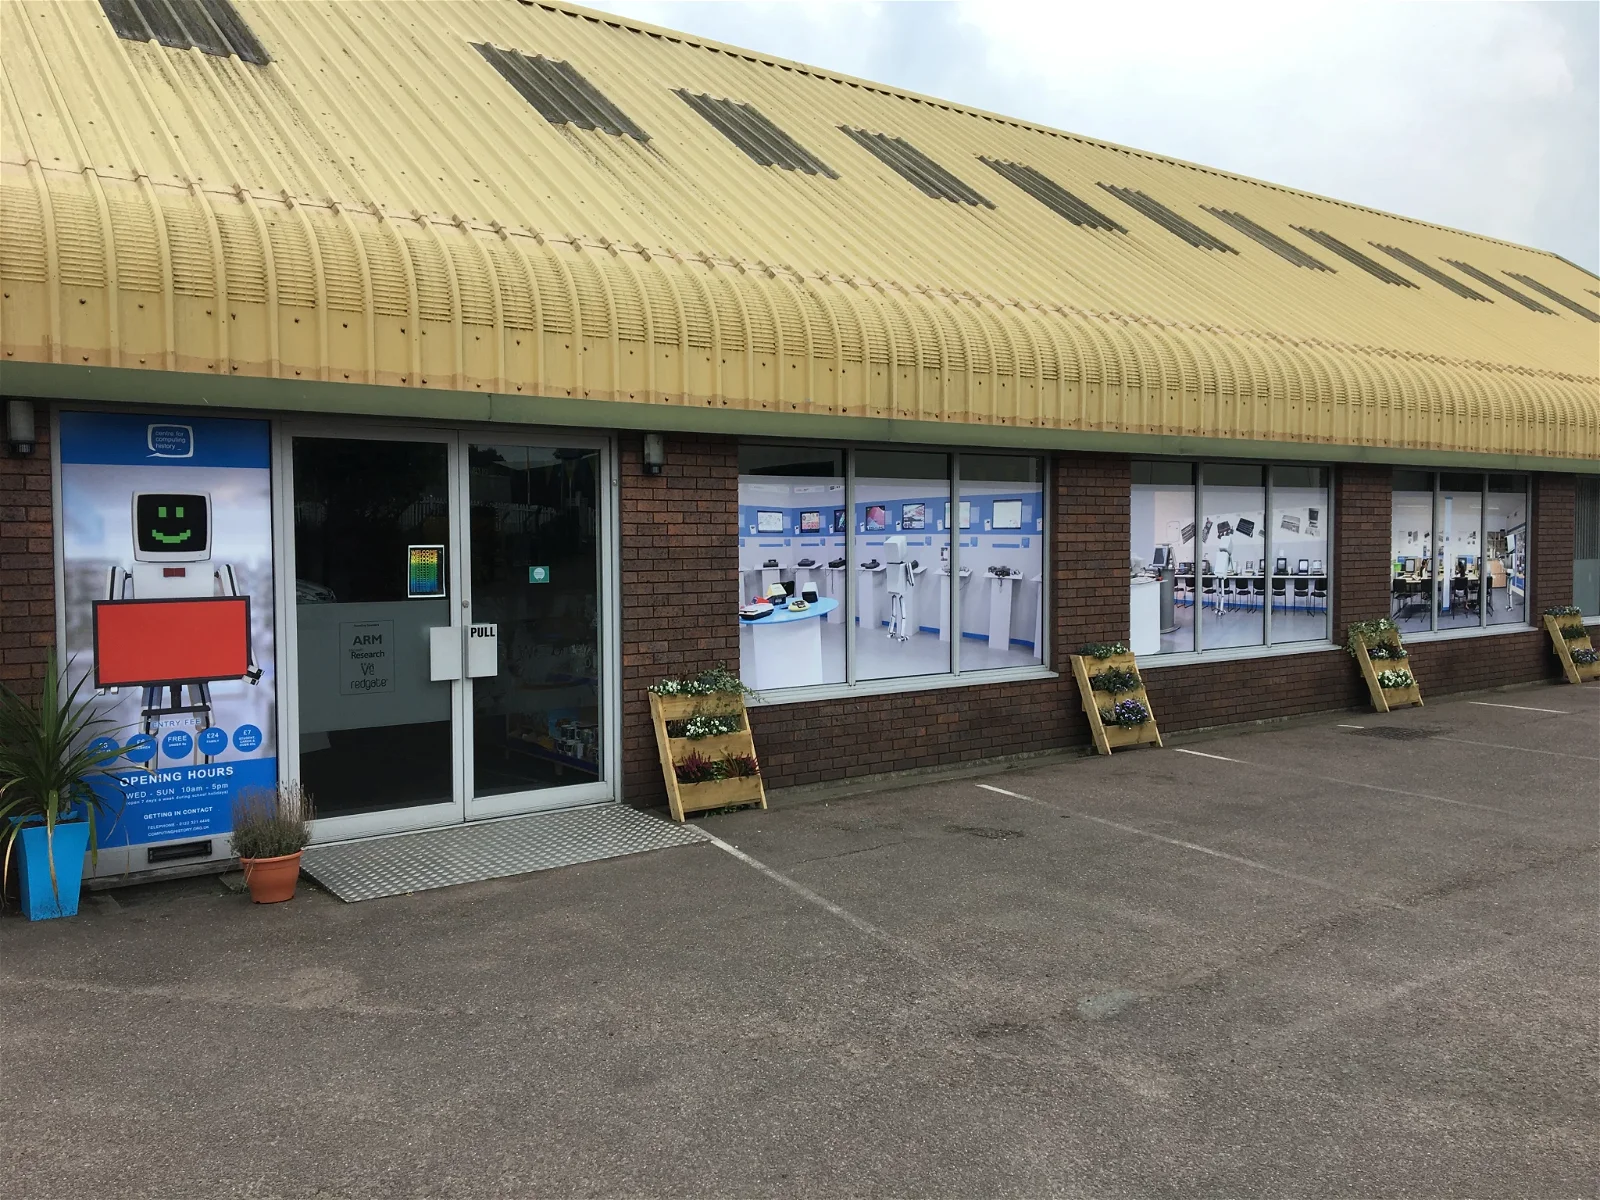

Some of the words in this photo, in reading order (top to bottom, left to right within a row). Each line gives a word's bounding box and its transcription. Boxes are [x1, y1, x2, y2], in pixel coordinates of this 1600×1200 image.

[470, 627, 496, 638] PULL
[353, 634, 383, 646] ARM
[351, 650, 385, 659] Research
[350, 678, 387, 690] redgate
[152, 720, 180, 728] ENTRY
[120, 772, 182, 787] OPENING
[188, 766, 234, 780] HOURS
[126, 791, 147, 799] WED
[156, 788, 175, 796] SUN
[143, 811, 173, 820] GETTING
[182, 806, 213, 815] CONTACT
